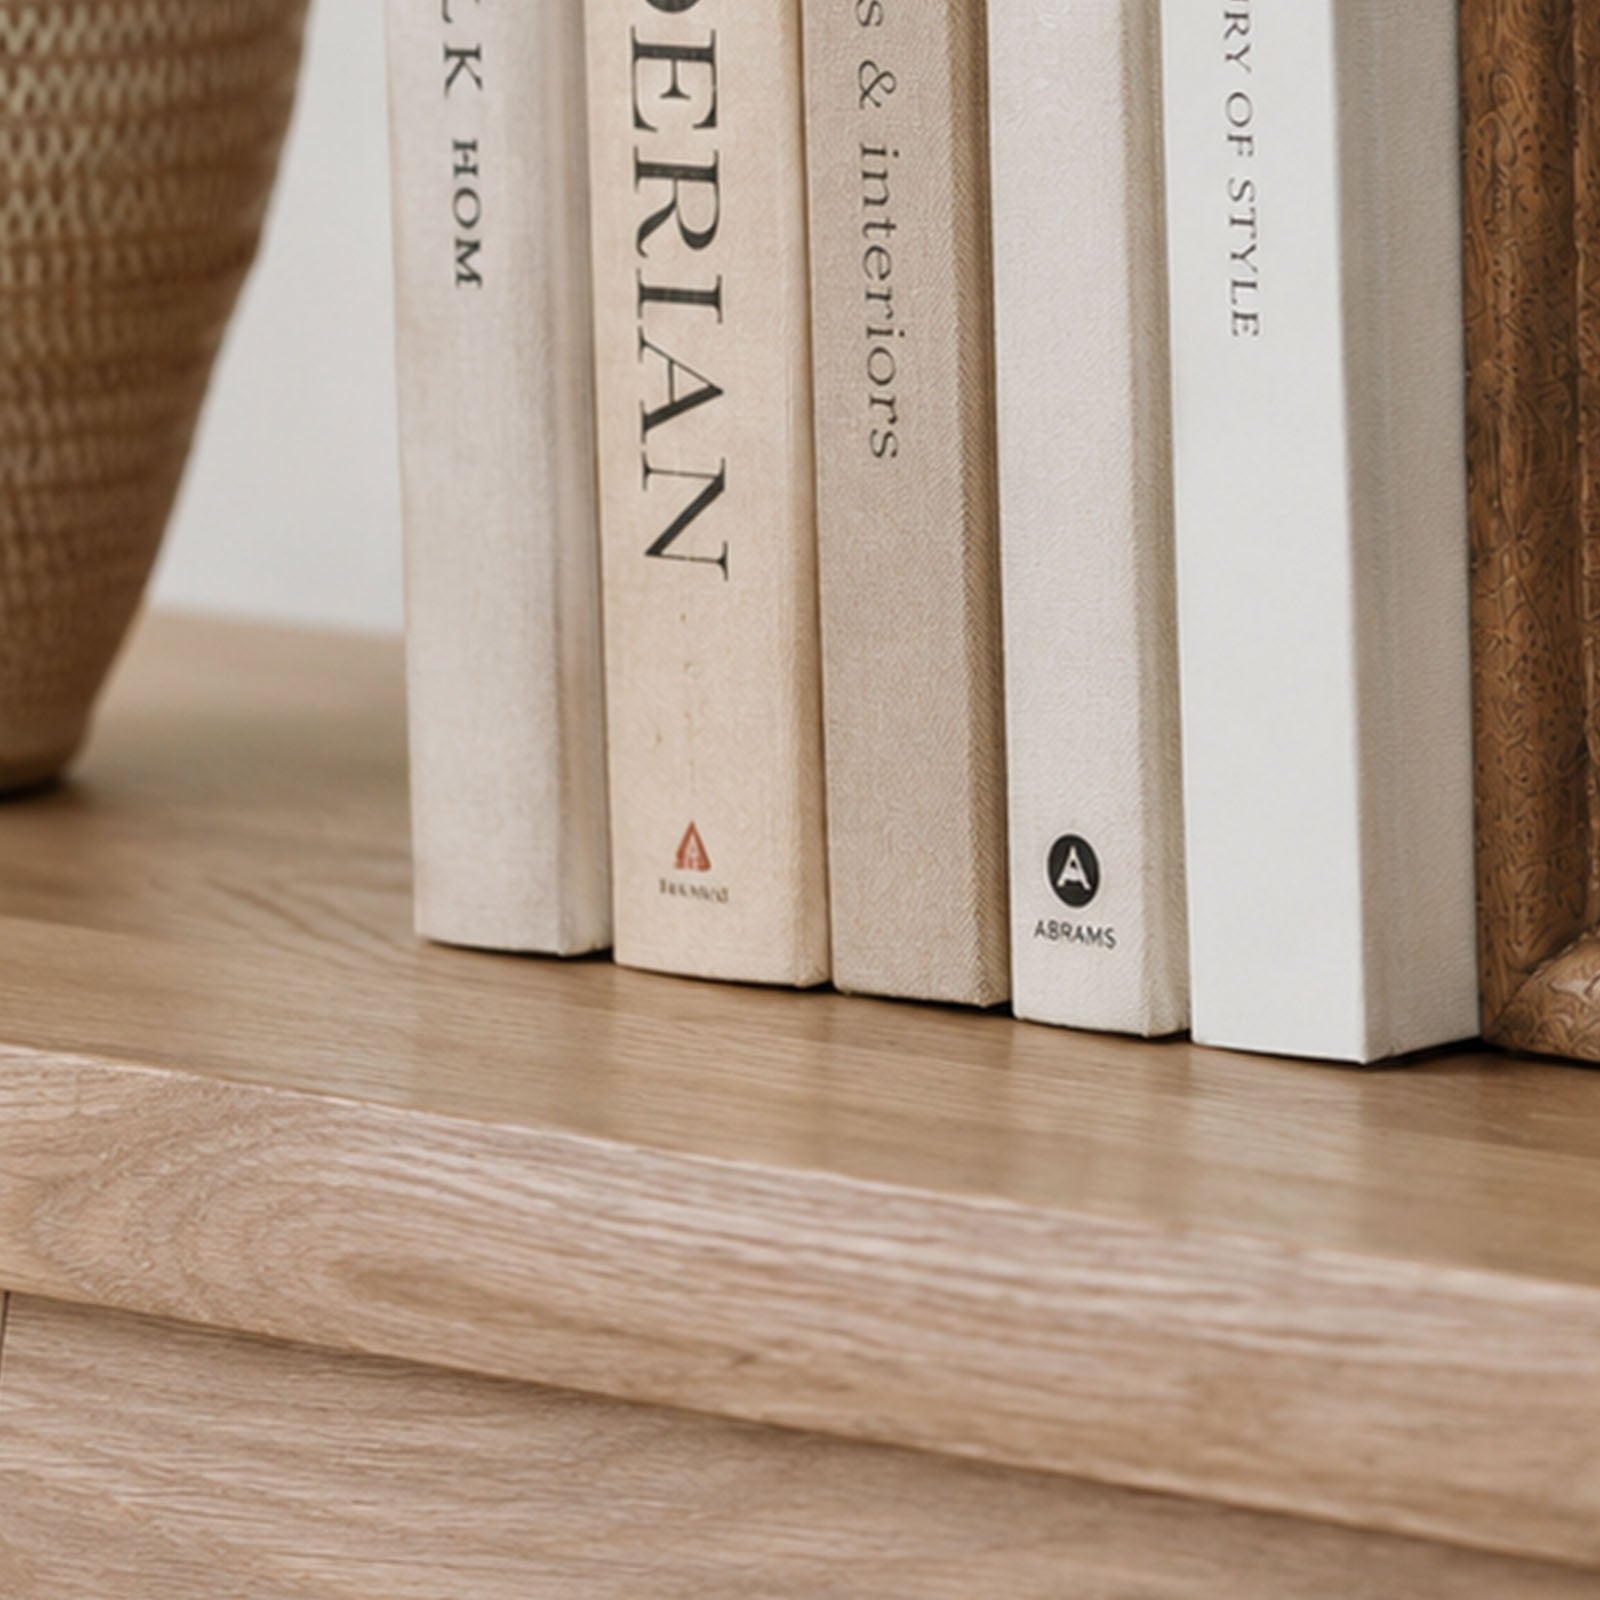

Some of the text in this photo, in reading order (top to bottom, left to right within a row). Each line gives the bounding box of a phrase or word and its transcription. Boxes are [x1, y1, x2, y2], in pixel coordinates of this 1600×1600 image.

[856, 58, 897, 111] &
[1225, 90, 1256, 158] OF
[451, 137, 485, 290] HOM
[1227, 176, 1261, 338] STYLE
[858, 141, 906, 460] interiors
[1057, 845, 1091, 890] A
[1033, 919, 1117, 950] ABRAMS
